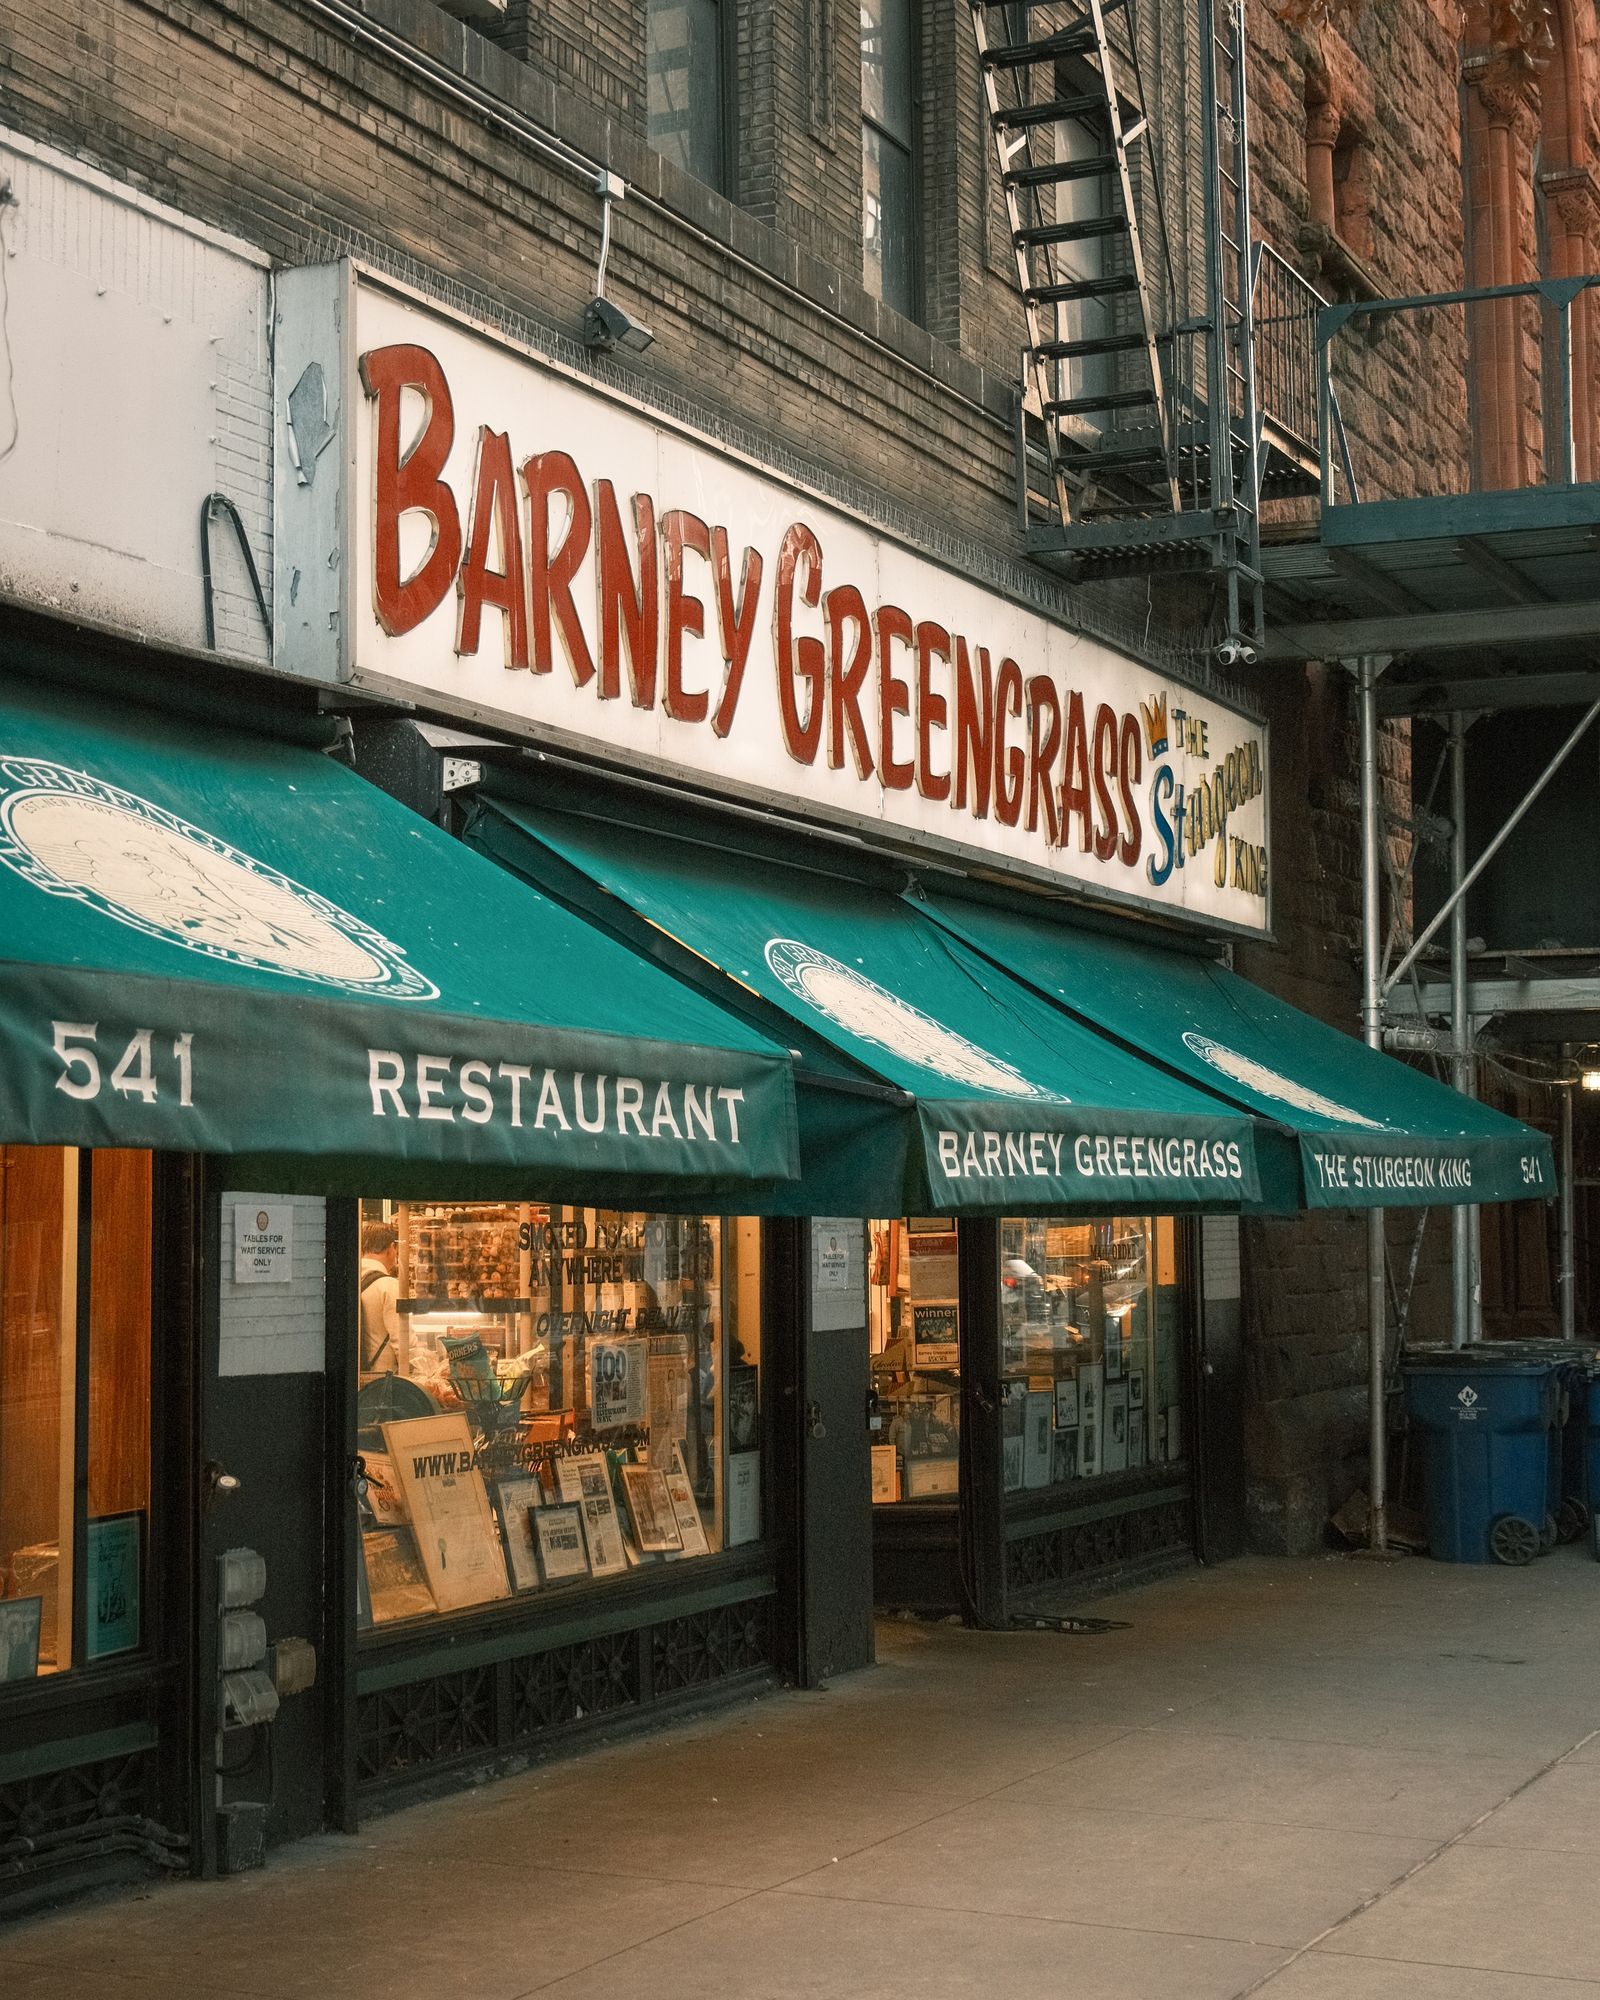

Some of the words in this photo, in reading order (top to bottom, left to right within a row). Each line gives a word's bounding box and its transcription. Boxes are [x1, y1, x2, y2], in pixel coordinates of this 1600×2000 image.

[359, 343, 762, 738] BARNEY
[772, 522, 1143, 868] GREENGRASS
[1171, 708, 1209, 759] THE
[1229, 834, 1268, 897] KING
[51, 1020, 195, 1107] 541
[367, 1048, 746, 1144] RESTAURANT
[938, 1130, 1065, 1178] BARNEY
[1073, 1133, 1243, 1179] GREENGRASS
[1314, 1152, 1350, 1188] THE
[1352, 1155, 1436, 1188] STURGEON
[1438, 1157, 1473, 1187] KING
[1520, 1156, 1545, 1184] 541
[241, 1246, 257, 1255] WAIT
[257, 1246, 286, 1255] SERVICE
[243, 1234, 269, 1243] TABLES
[269, 1235, 283, 1243] FOR
[253, 1258, 272, 1267] ONLY
[528, 1256, 625, 1287] ANYWHERE
[914, 1308, 957, 1319] winner
[596, 1350, 627, 1382] 100
